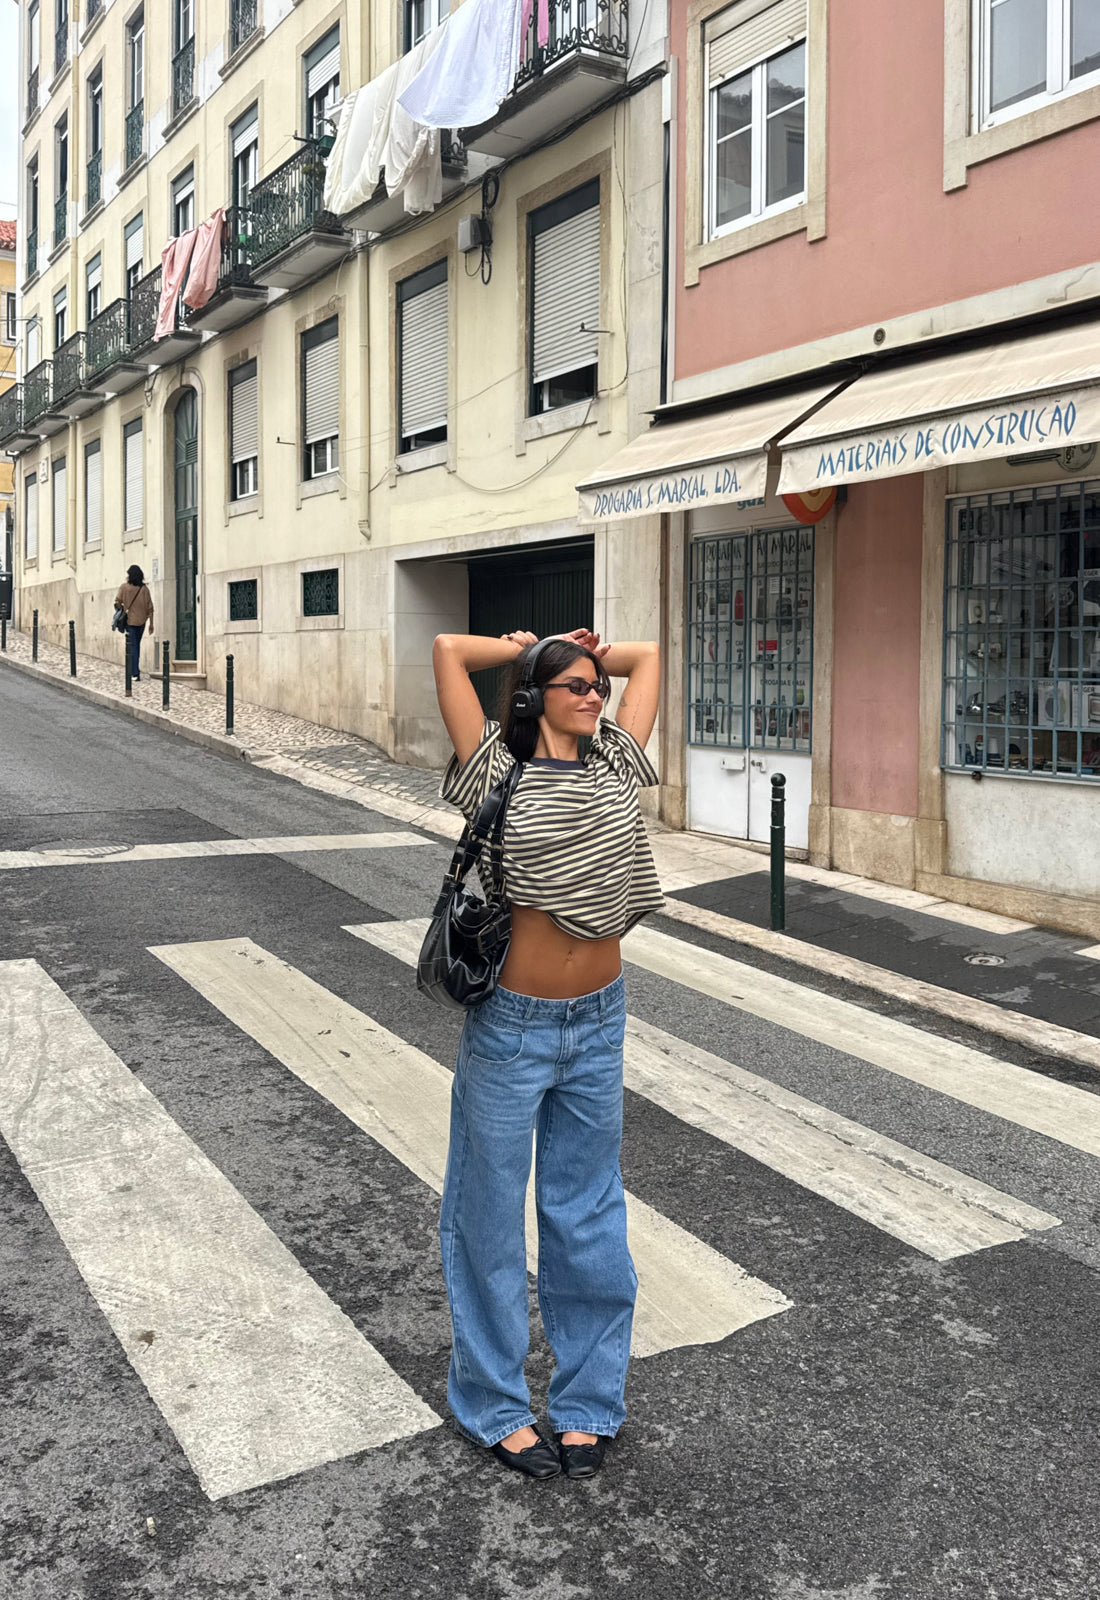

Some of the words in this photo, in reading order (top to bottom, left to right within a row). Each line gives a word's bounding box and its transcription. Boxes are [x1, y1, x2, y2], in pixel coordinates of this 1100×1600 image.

[914, 428, 935, 460] DE
[942, 400, 1077, 455] CONSTRUÇÃO
[593, 486, 642, 517] DROGARIA
[714, 468, 742, 494] LDA.
